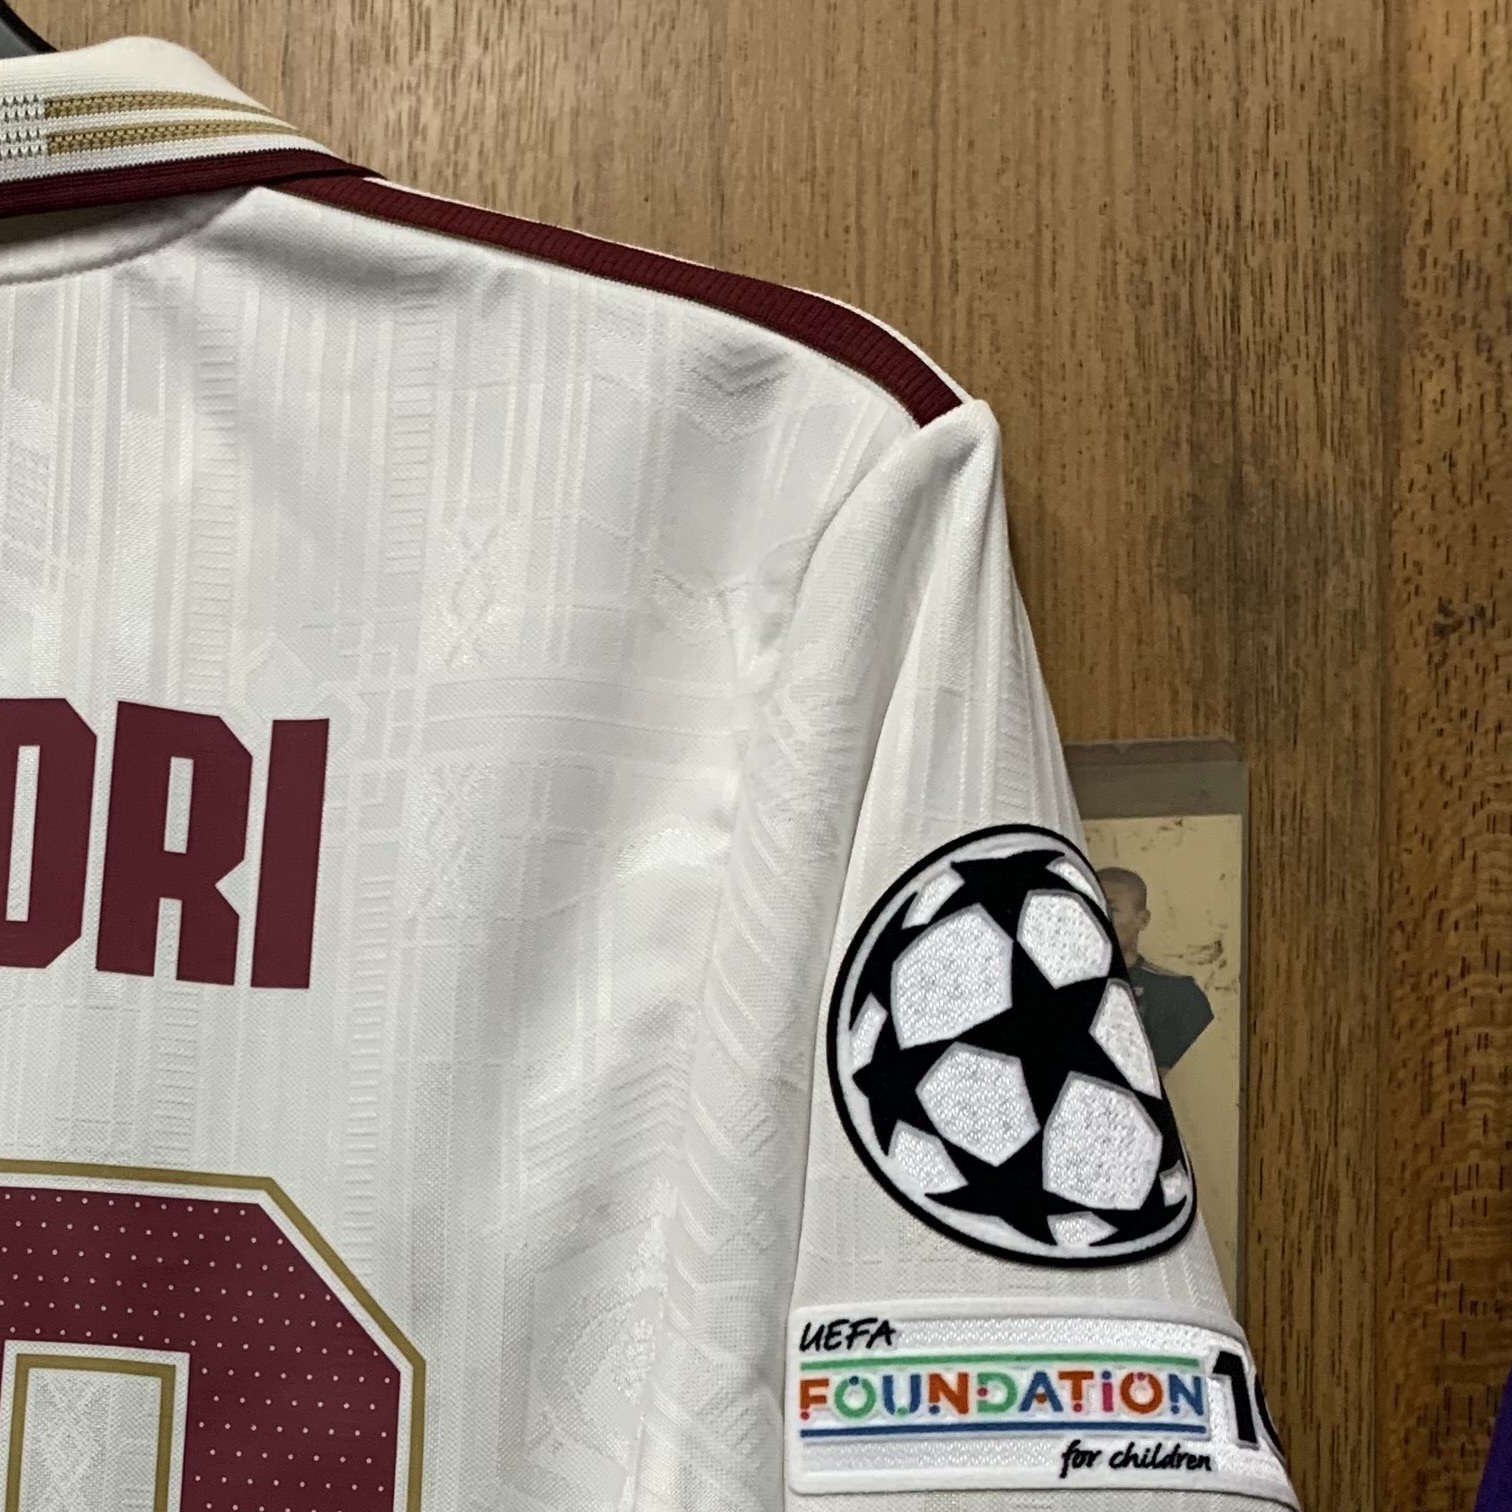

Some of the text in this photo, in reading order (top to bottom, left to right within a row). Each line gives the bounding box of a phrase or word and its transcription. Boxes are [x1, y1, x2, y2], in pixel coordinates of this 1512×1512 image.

[799, 1318, 898, 1352] UEFA
[1059, 1440, 1212, 1478] for children
